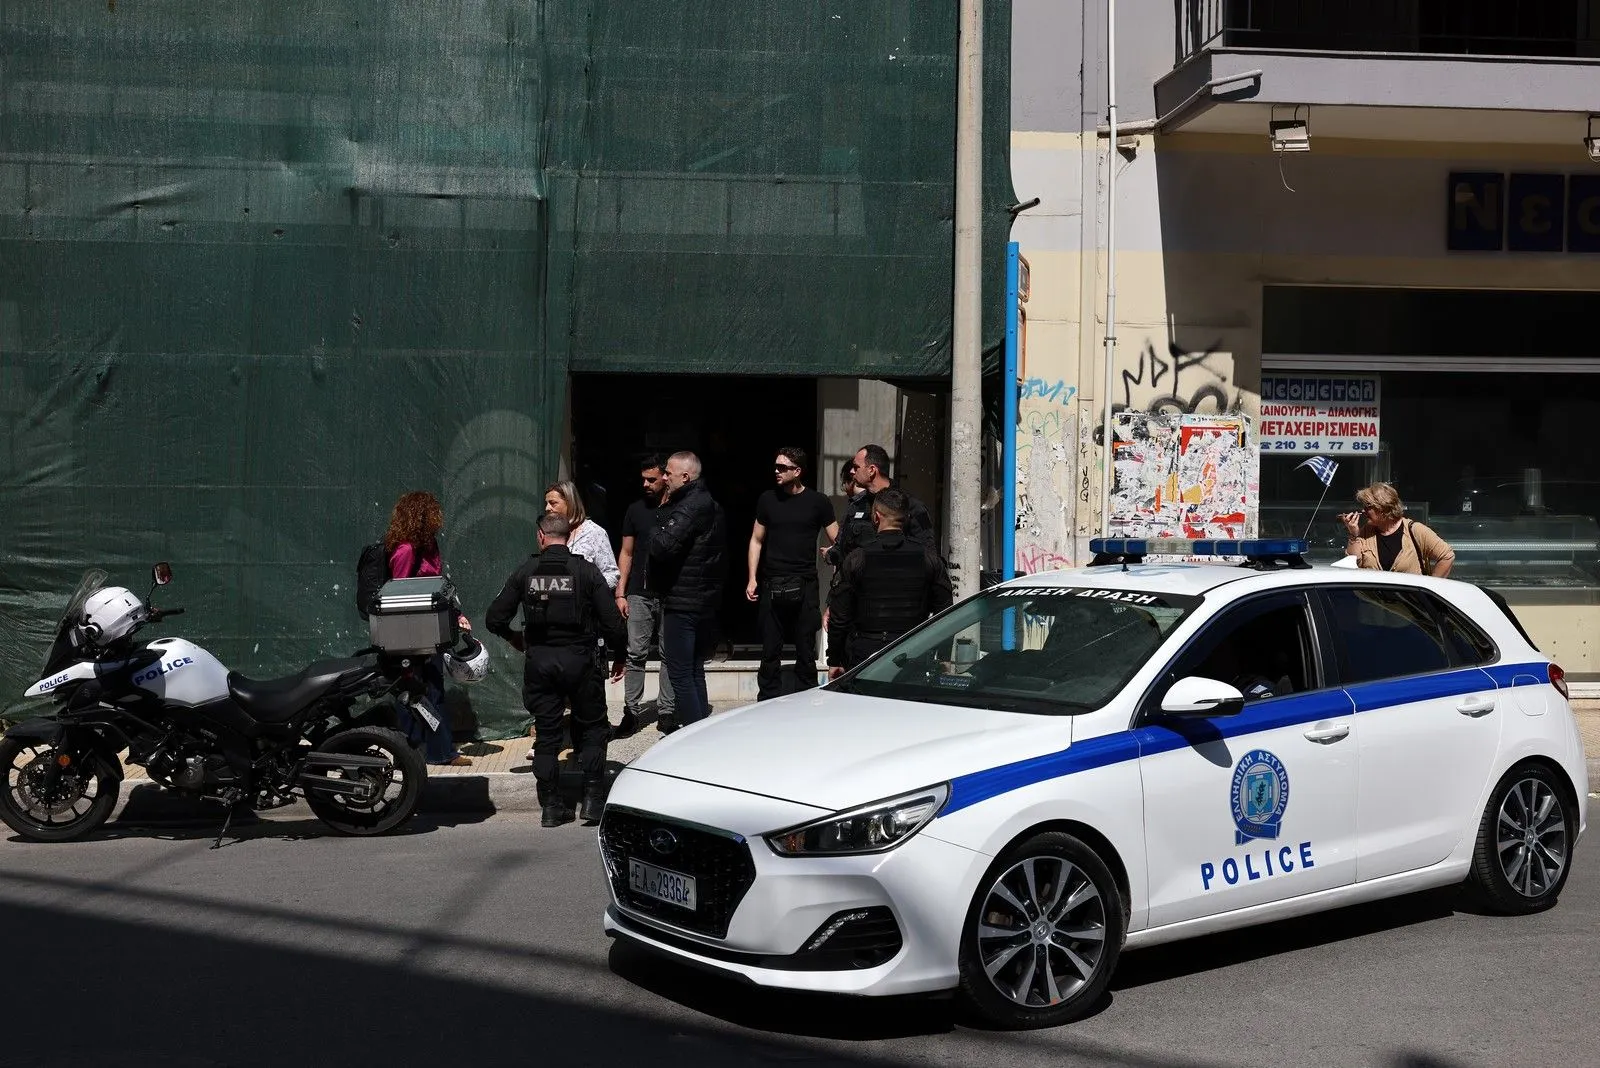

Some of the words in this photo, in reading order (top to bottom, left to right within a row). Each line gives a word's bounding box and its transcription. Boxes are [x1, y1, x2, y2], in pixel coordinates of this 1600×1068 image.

[1328, 407, 1378, 418] ΔΙΑΛΟΓΗΣ
[1260, 421, 1377, 437] ΜΕΤΑΧΕΙΡΙΣΜΕΝΑ
[1275, 441, 1297, 450] 210
[1304, 441, 1319, 450] 34
[1329, 441, 1343, 450] 77
[1352, 441, 1374, 450] 851
[997, 588, 1073, 598] ΑΜΕΣΗ
[1075, 591, 1158, 604] ΔΡΑΣΗ
[134, 656, 194, 686] POLICE
[39, 673, 70, 691] POLICE
[1232, 755, 1253, 822] ΕΛΛΗΝΙΚΗ
[1257, 752, 1288, 816] ΑΣΤΥΝΟΜΙΑ
[1200, 841, 1315, 890] POLICE
